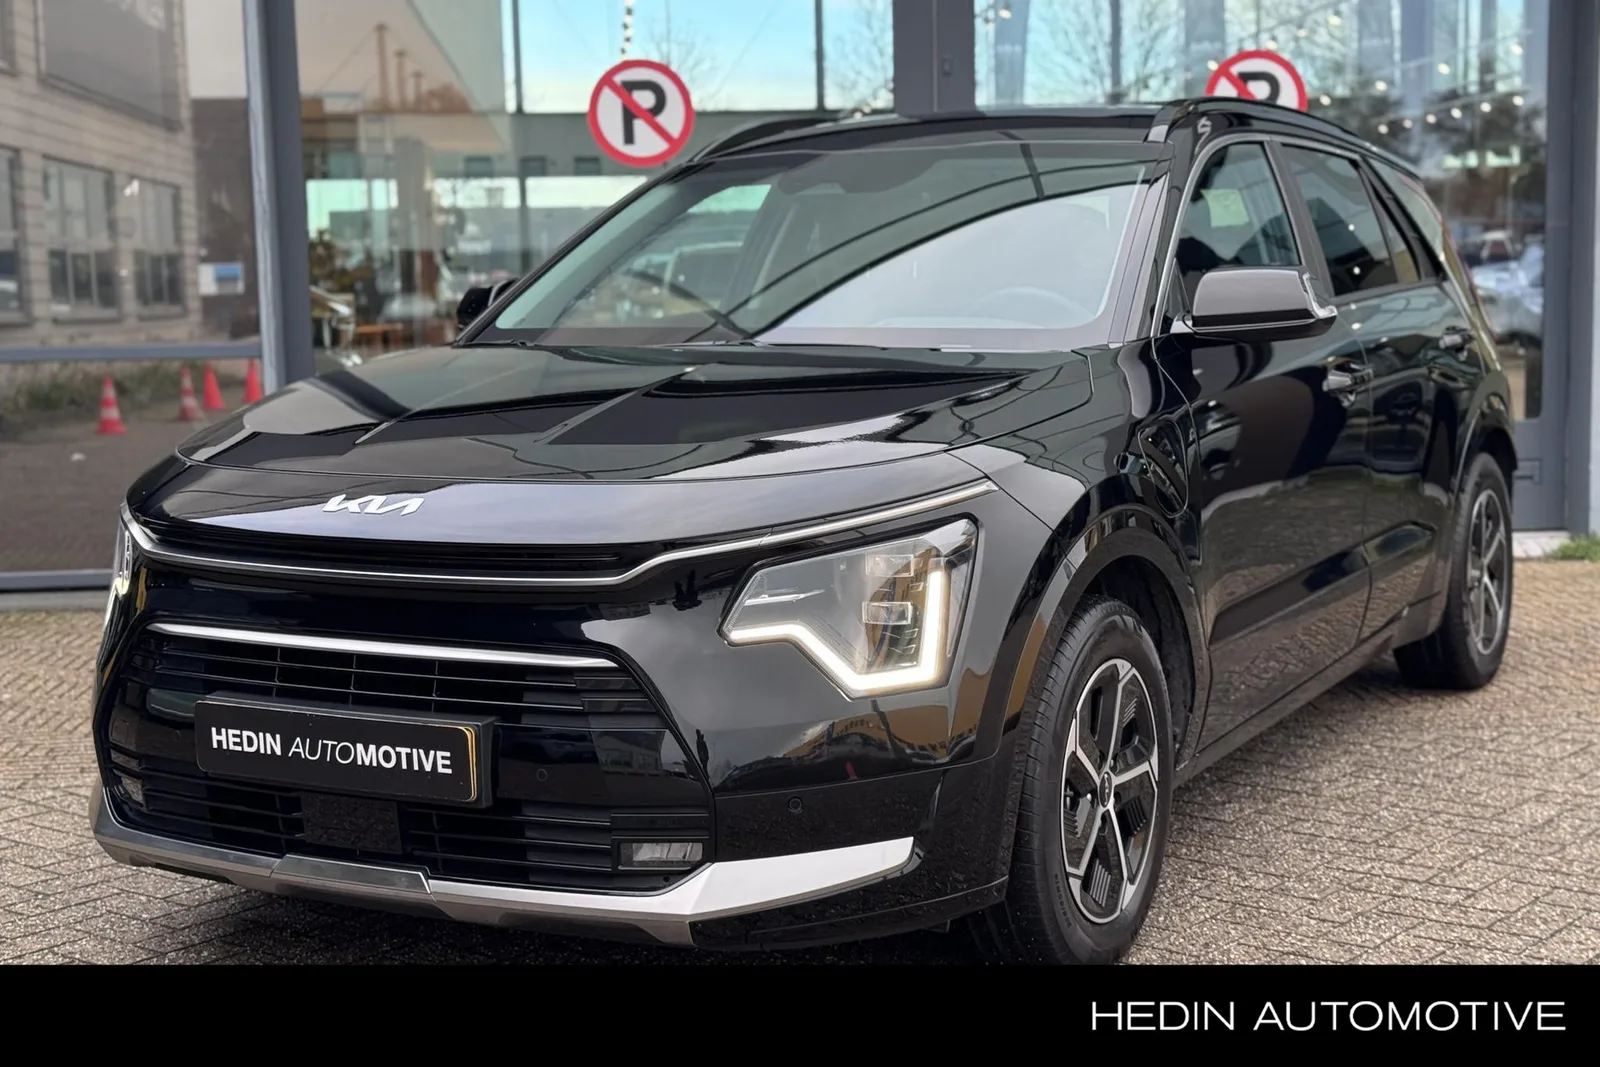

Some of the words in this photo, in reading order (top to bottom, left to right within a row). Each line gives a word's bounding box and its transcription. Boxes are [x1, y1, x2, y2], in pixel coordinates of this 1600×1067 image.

[620, 80, 667, 145] P
[322, 493, 425, 517] KIA
[211, 726, 282, 757] HEDIN
[288, 736, 453, 774] AUTOMOTIVE
